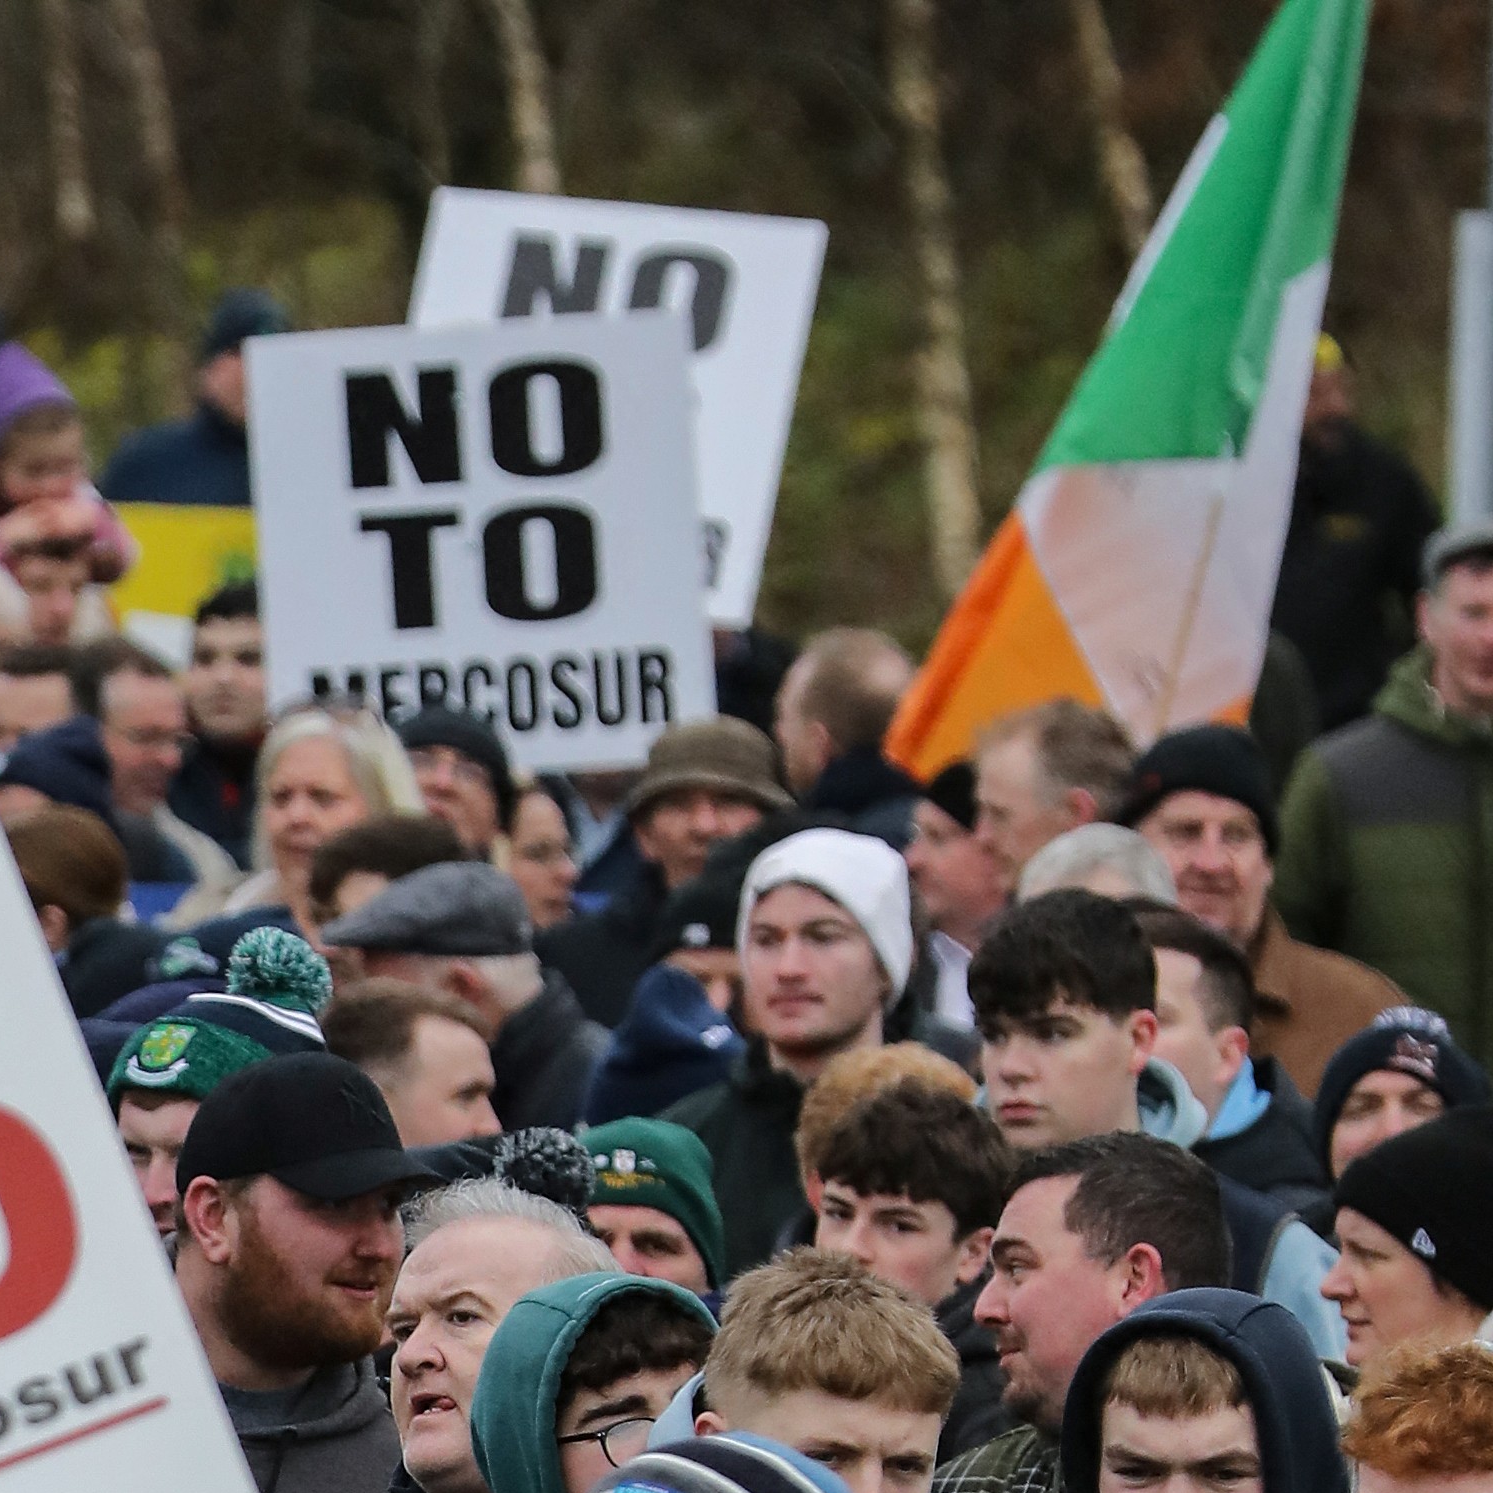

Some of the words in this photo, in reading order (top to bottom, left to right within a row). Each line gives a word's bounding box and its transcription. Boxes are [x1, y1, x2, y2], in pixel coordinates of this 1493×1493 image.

[498, 232, 734, 352] NO
[344, 358, 605, 490] NO
[358, 503, 600, 632] TO
